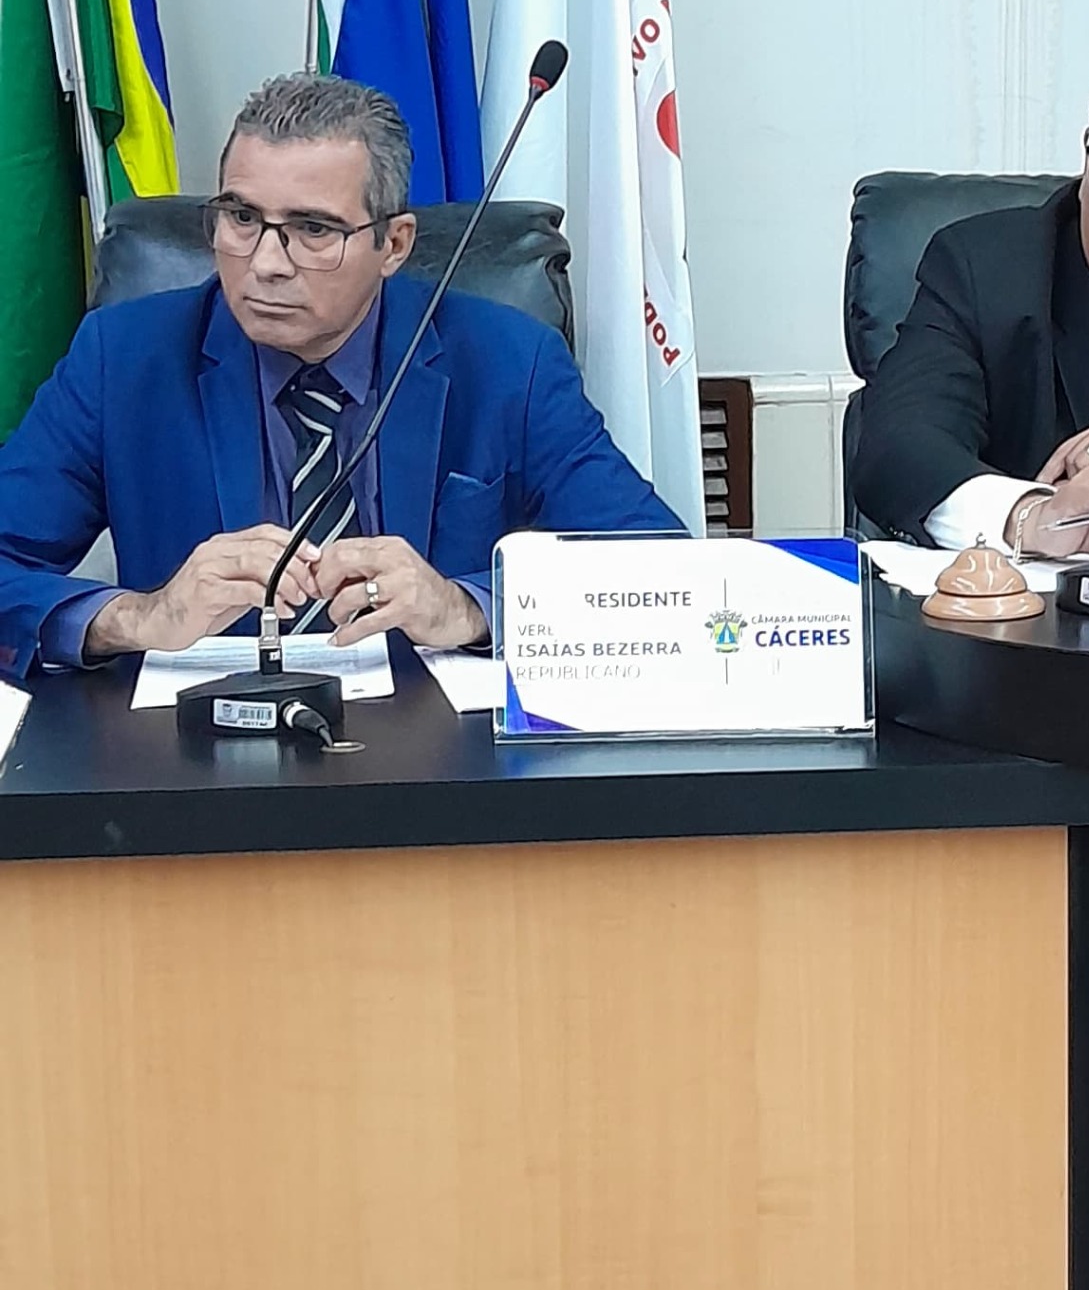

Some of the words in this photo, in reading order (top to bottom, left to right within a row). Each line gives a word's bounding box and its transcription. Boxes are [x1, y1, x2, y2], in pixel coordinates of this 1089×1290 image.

[755, 625, 850, 647] CÁCERES
[517, 639, 586, 657] ISAÍAS
[593, 642, 682, 656] BEZERRA
